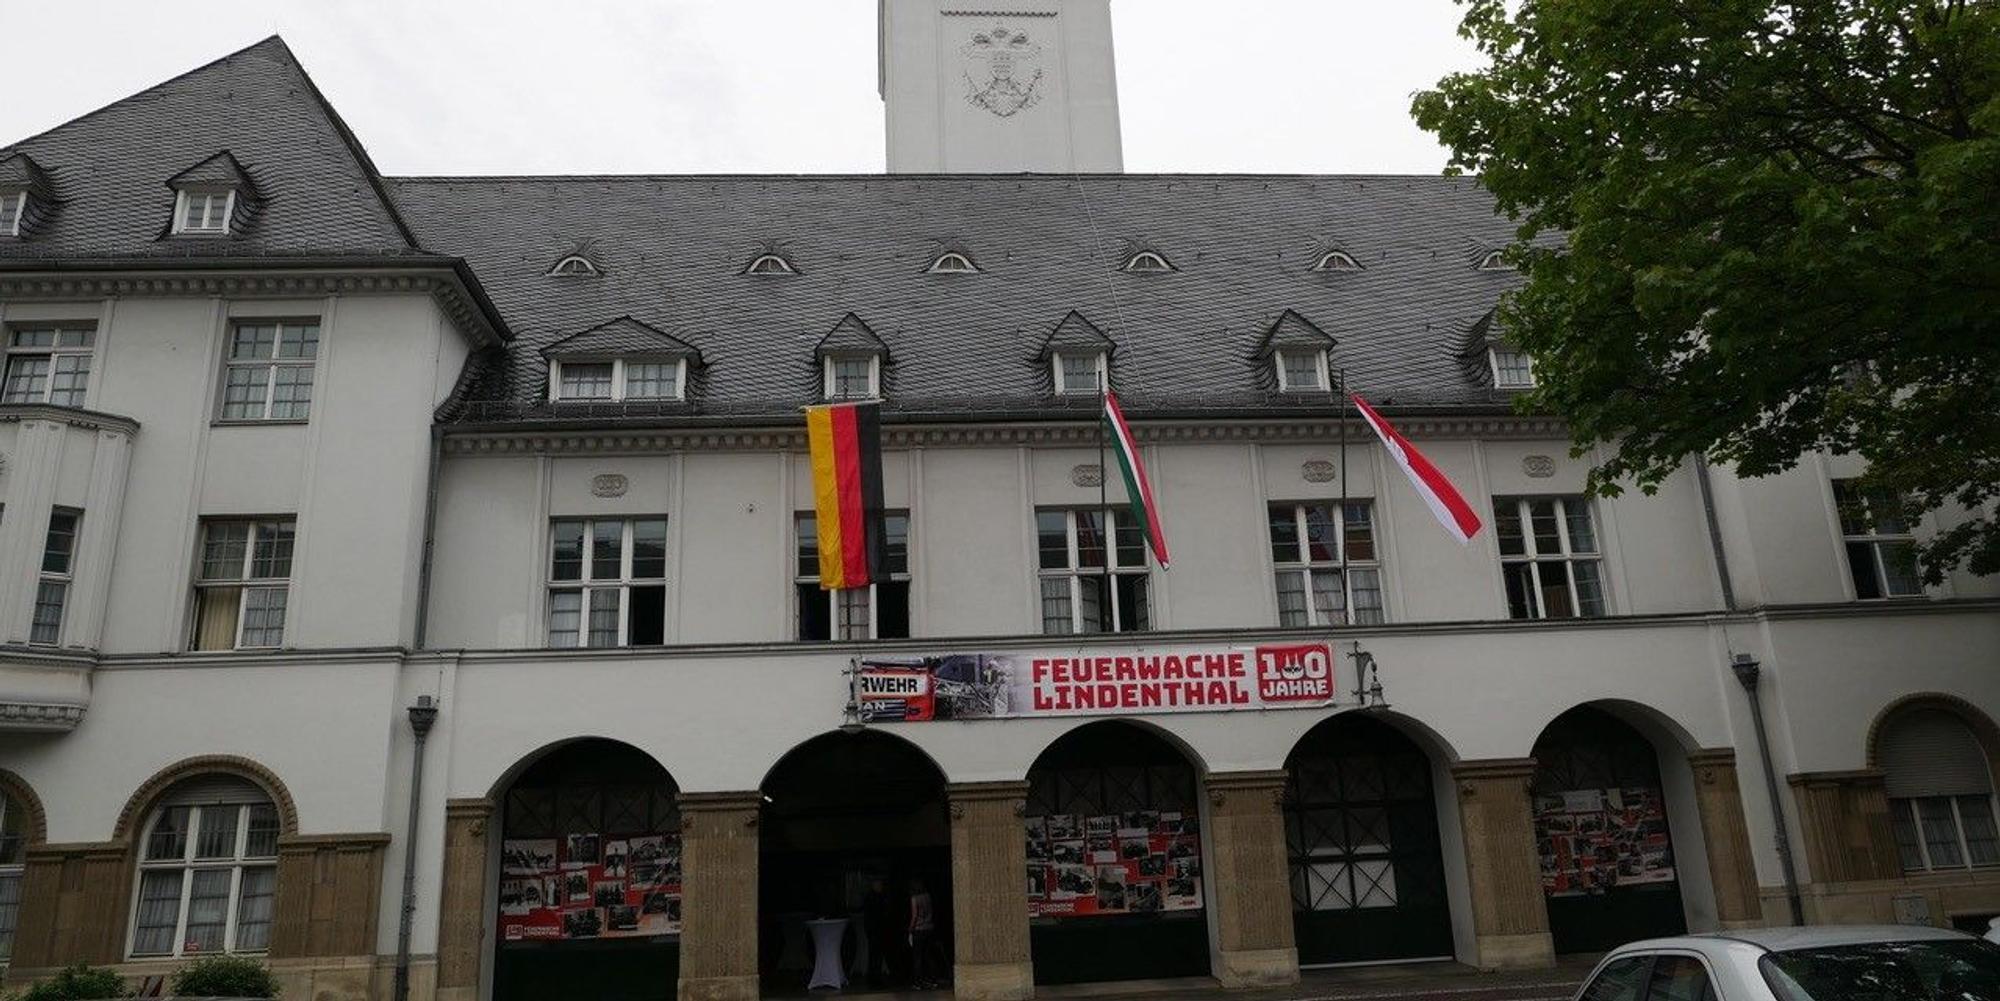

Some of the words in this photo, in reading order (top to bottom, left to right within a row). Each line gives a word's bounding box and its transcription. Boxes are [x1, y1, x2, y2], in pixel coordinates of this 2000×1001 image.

[1033, 654, 1245, 683] FEUERWACHE
[1034, 681, 1249, 710] LINDENTHAL
[1263, 679, 1328, 697] JAHRE
